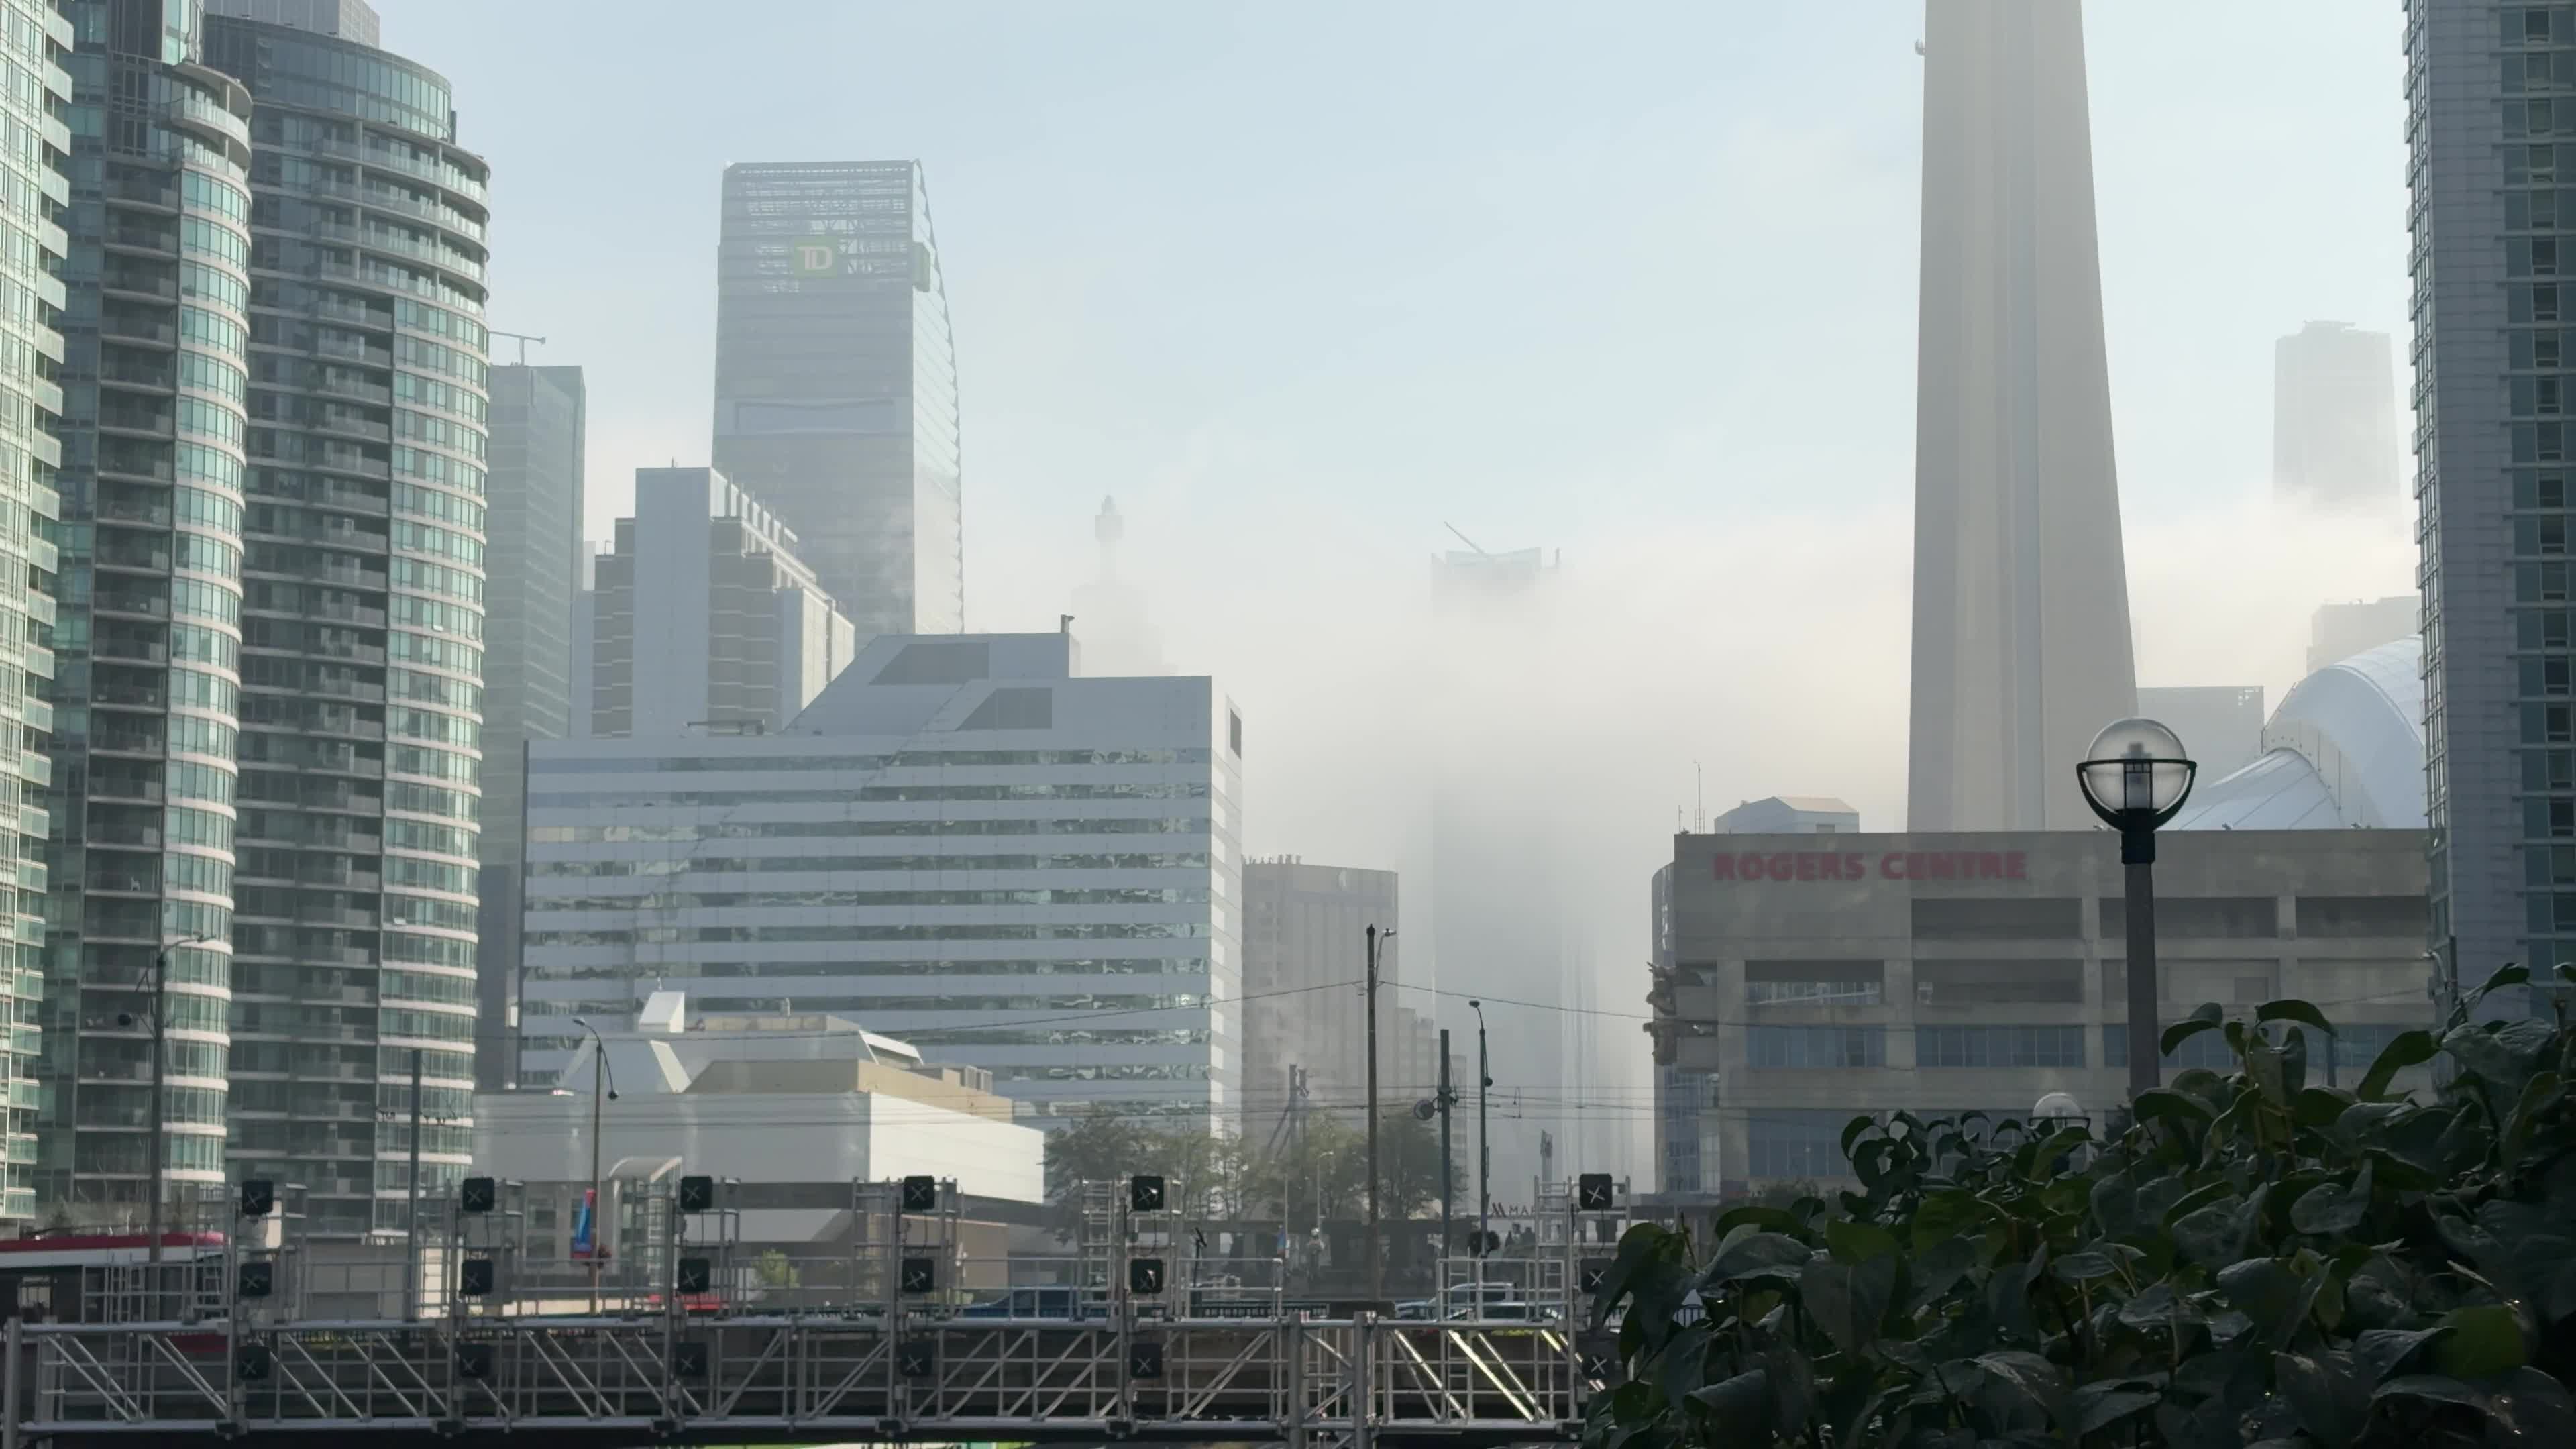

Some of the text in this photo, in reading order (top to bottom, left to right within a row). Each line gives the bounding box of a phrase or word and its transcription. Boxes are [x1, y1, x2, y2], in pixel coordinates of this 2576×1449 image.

[796, 246, 833, 270] TD
[1713, 851, 2028, 881] ROGERS CENTRE
